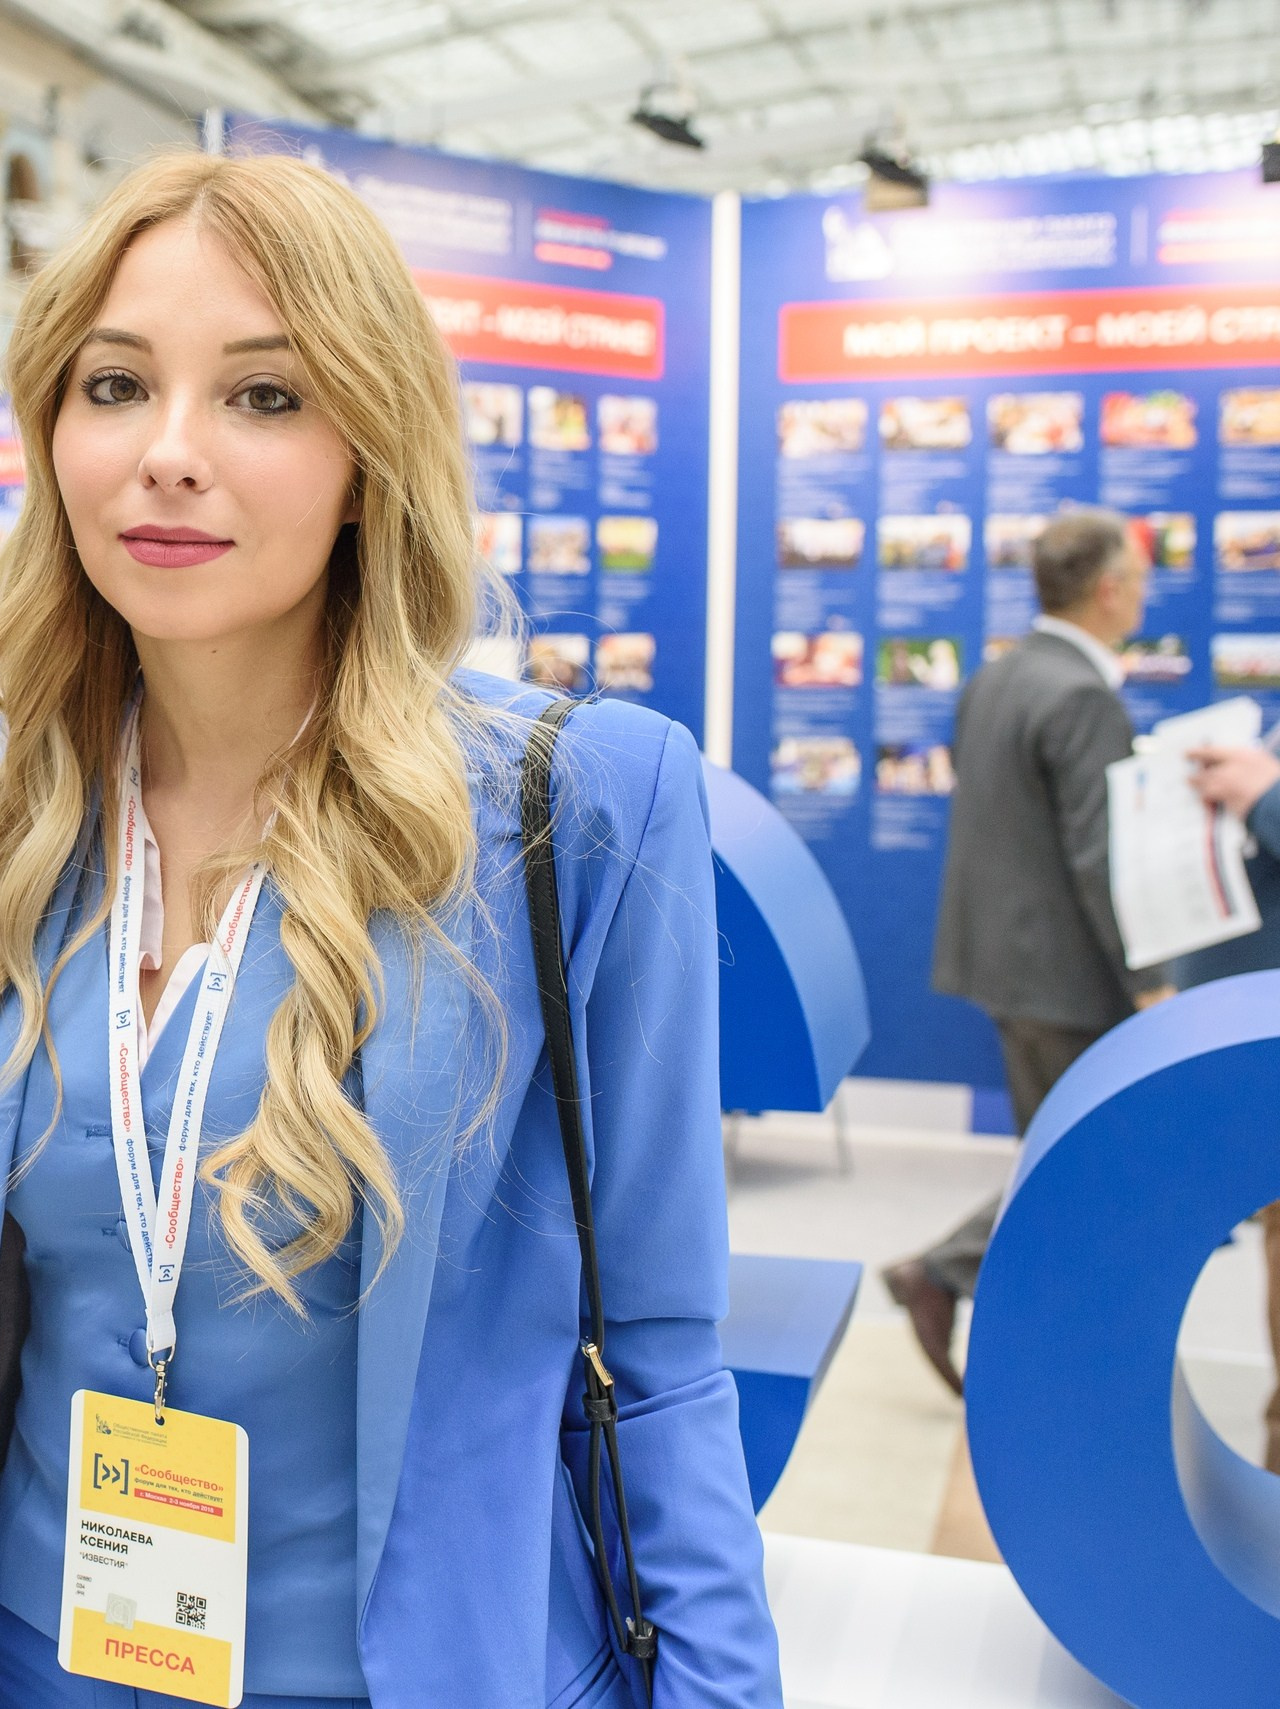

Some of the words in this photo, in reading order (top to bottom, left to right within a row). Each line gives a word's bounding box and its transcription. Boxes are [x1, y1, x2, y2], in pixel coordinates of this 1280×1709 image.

[932, 316, 1066, 352] ПРОЕКТ
[1099, 307, 1204, 346] МОЕЙ
[123, 876, 133, 903] форум
[122, 904, 130, 918] для
[120, 937, 128, 951] кто
[118, 953, 126, 993] действует
[197, 1010, 214, 1059] действует
[192, 1059, 201, 1076] кто
[120, 1042, 131, 1133] «Сообщество»
[187, 1078, 199, 1097] тех,
[184, 1099, 193, 1117] для
[178, 1118, 190, 1151] форум
[126, 1138, 137, 1171] форум
[131, 1172, 140, 1188] для
[135, 1189, 144, 1210] тех,
[164, 1157, 184, 1249] «Сообщество»
[139, 1211, 147, 1228] кто
[134, 1477, 154, 1487] форум
[155, 1481, 167, 1489] для
[192, 1491, 224, 1503] действует
[135, 1464, 224, 1492] «Сообщество»
[144, 1491, 167, 1502] Москва
[178, 1500, 200, 1511] ноября
[80, 1519, 154, 1547] НИКОЛАЕВА
[80, 1533, 129, 1555] КСЕНИЯ
[105, 1638, 196, 1675] ПРЕССА
